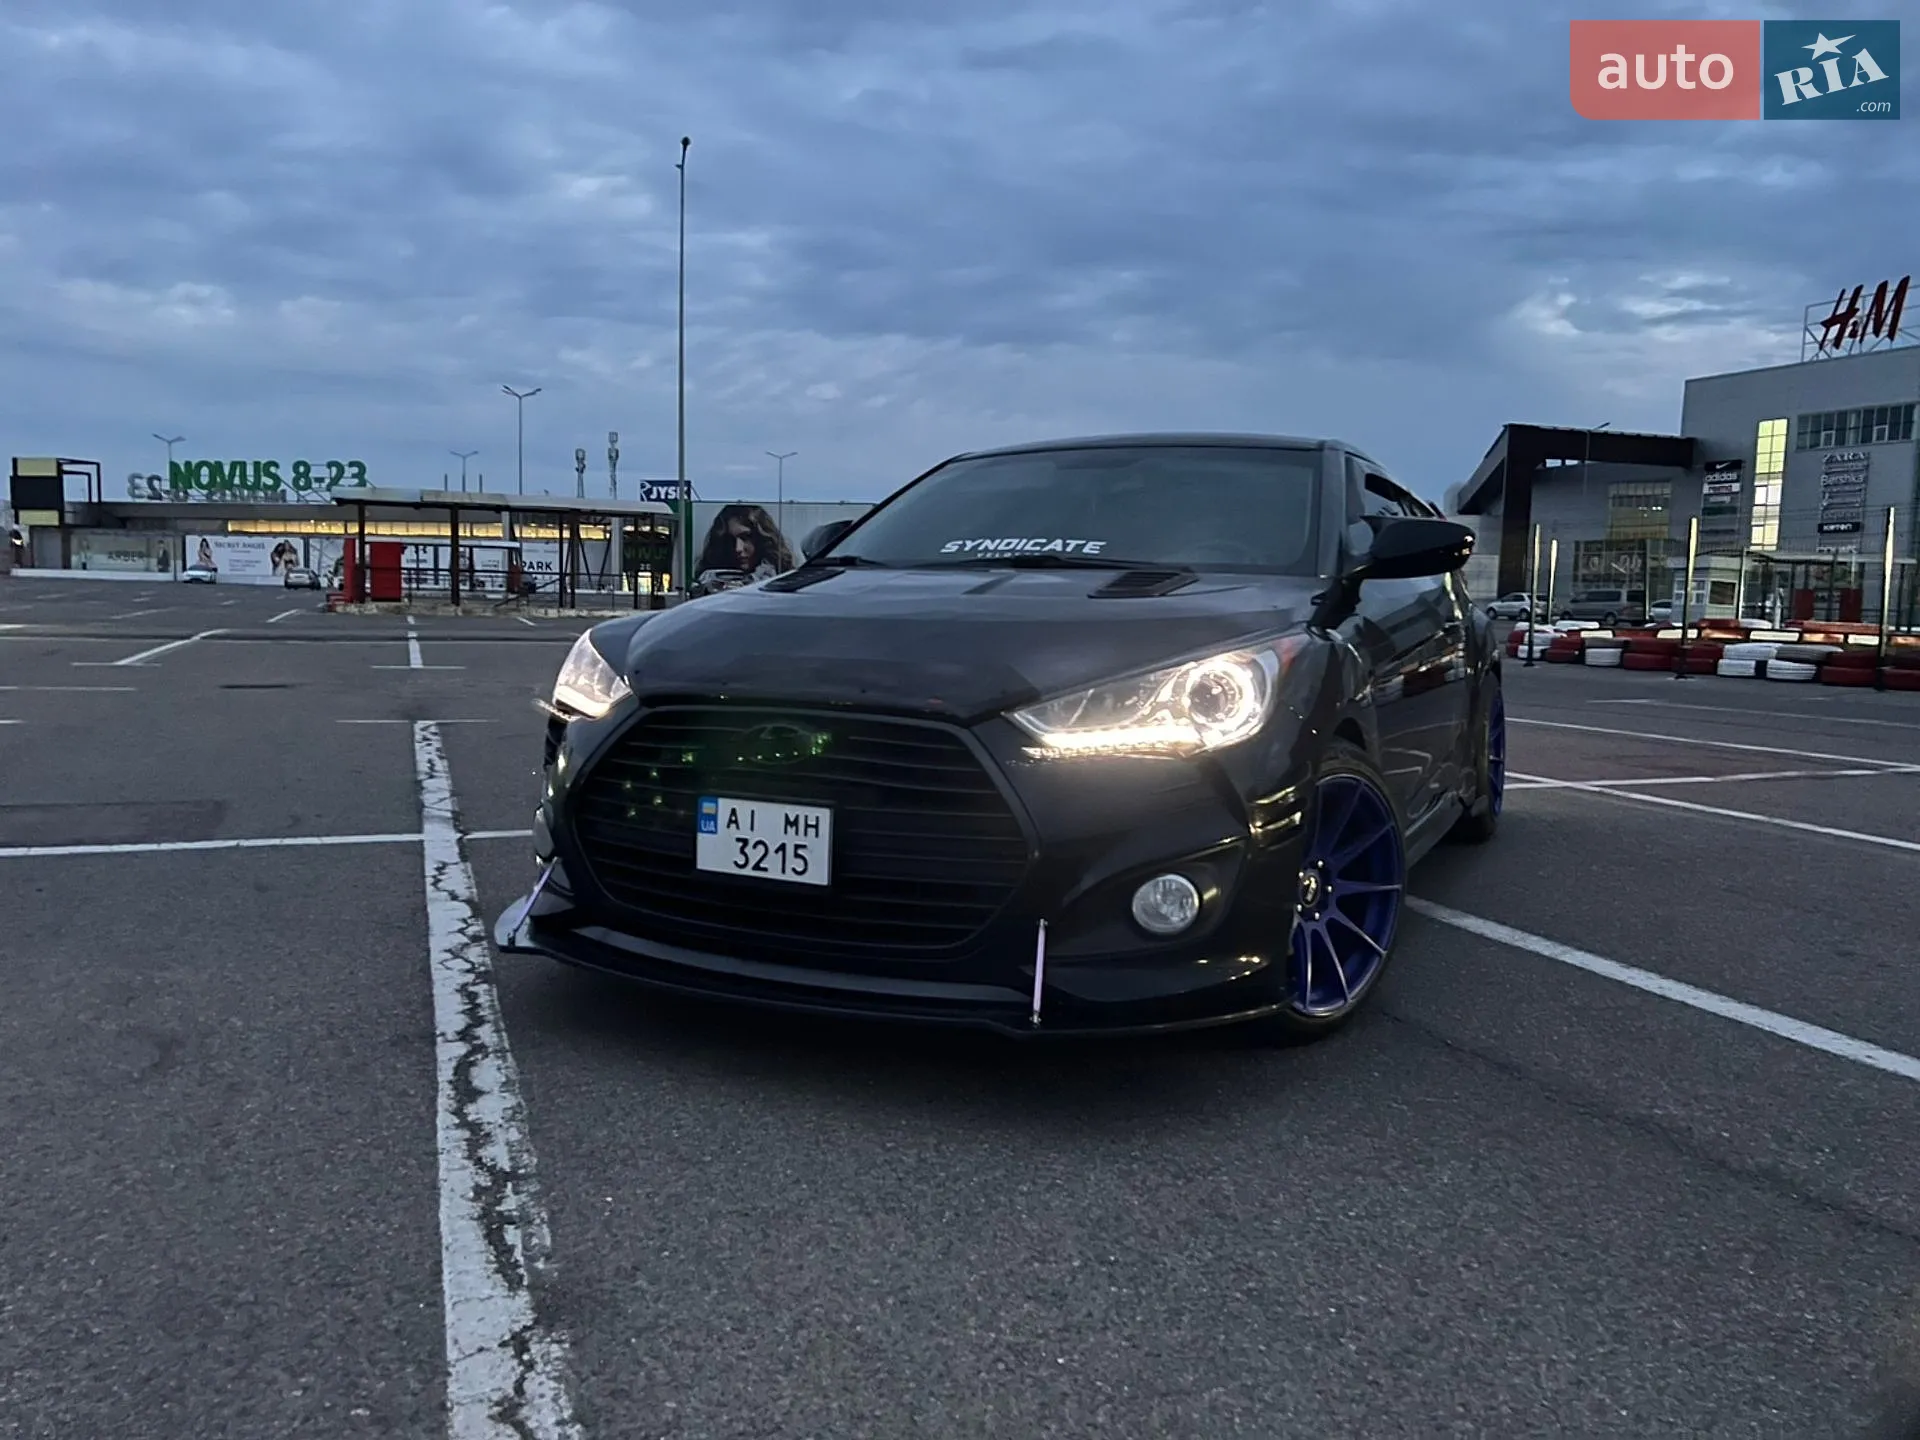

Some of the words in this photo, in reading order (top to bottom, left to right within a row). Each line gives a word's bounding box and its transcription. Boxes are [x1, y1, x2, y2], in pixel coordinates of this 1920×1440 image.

[1820, 275, 1910, 350] H&M
[169, 460, 280, 491] NOVUS
[292, 460, 368, 492] 8-23
[1705, 472, 1738, 482] adidas
[940, 538, 1107, 554] SYNDICATE
[701, 820, 716, 832] UA
[726, 807, 755, 832] AI
[784, 812, 820, 838] MH
[733, 837, 808, 876] 3215
